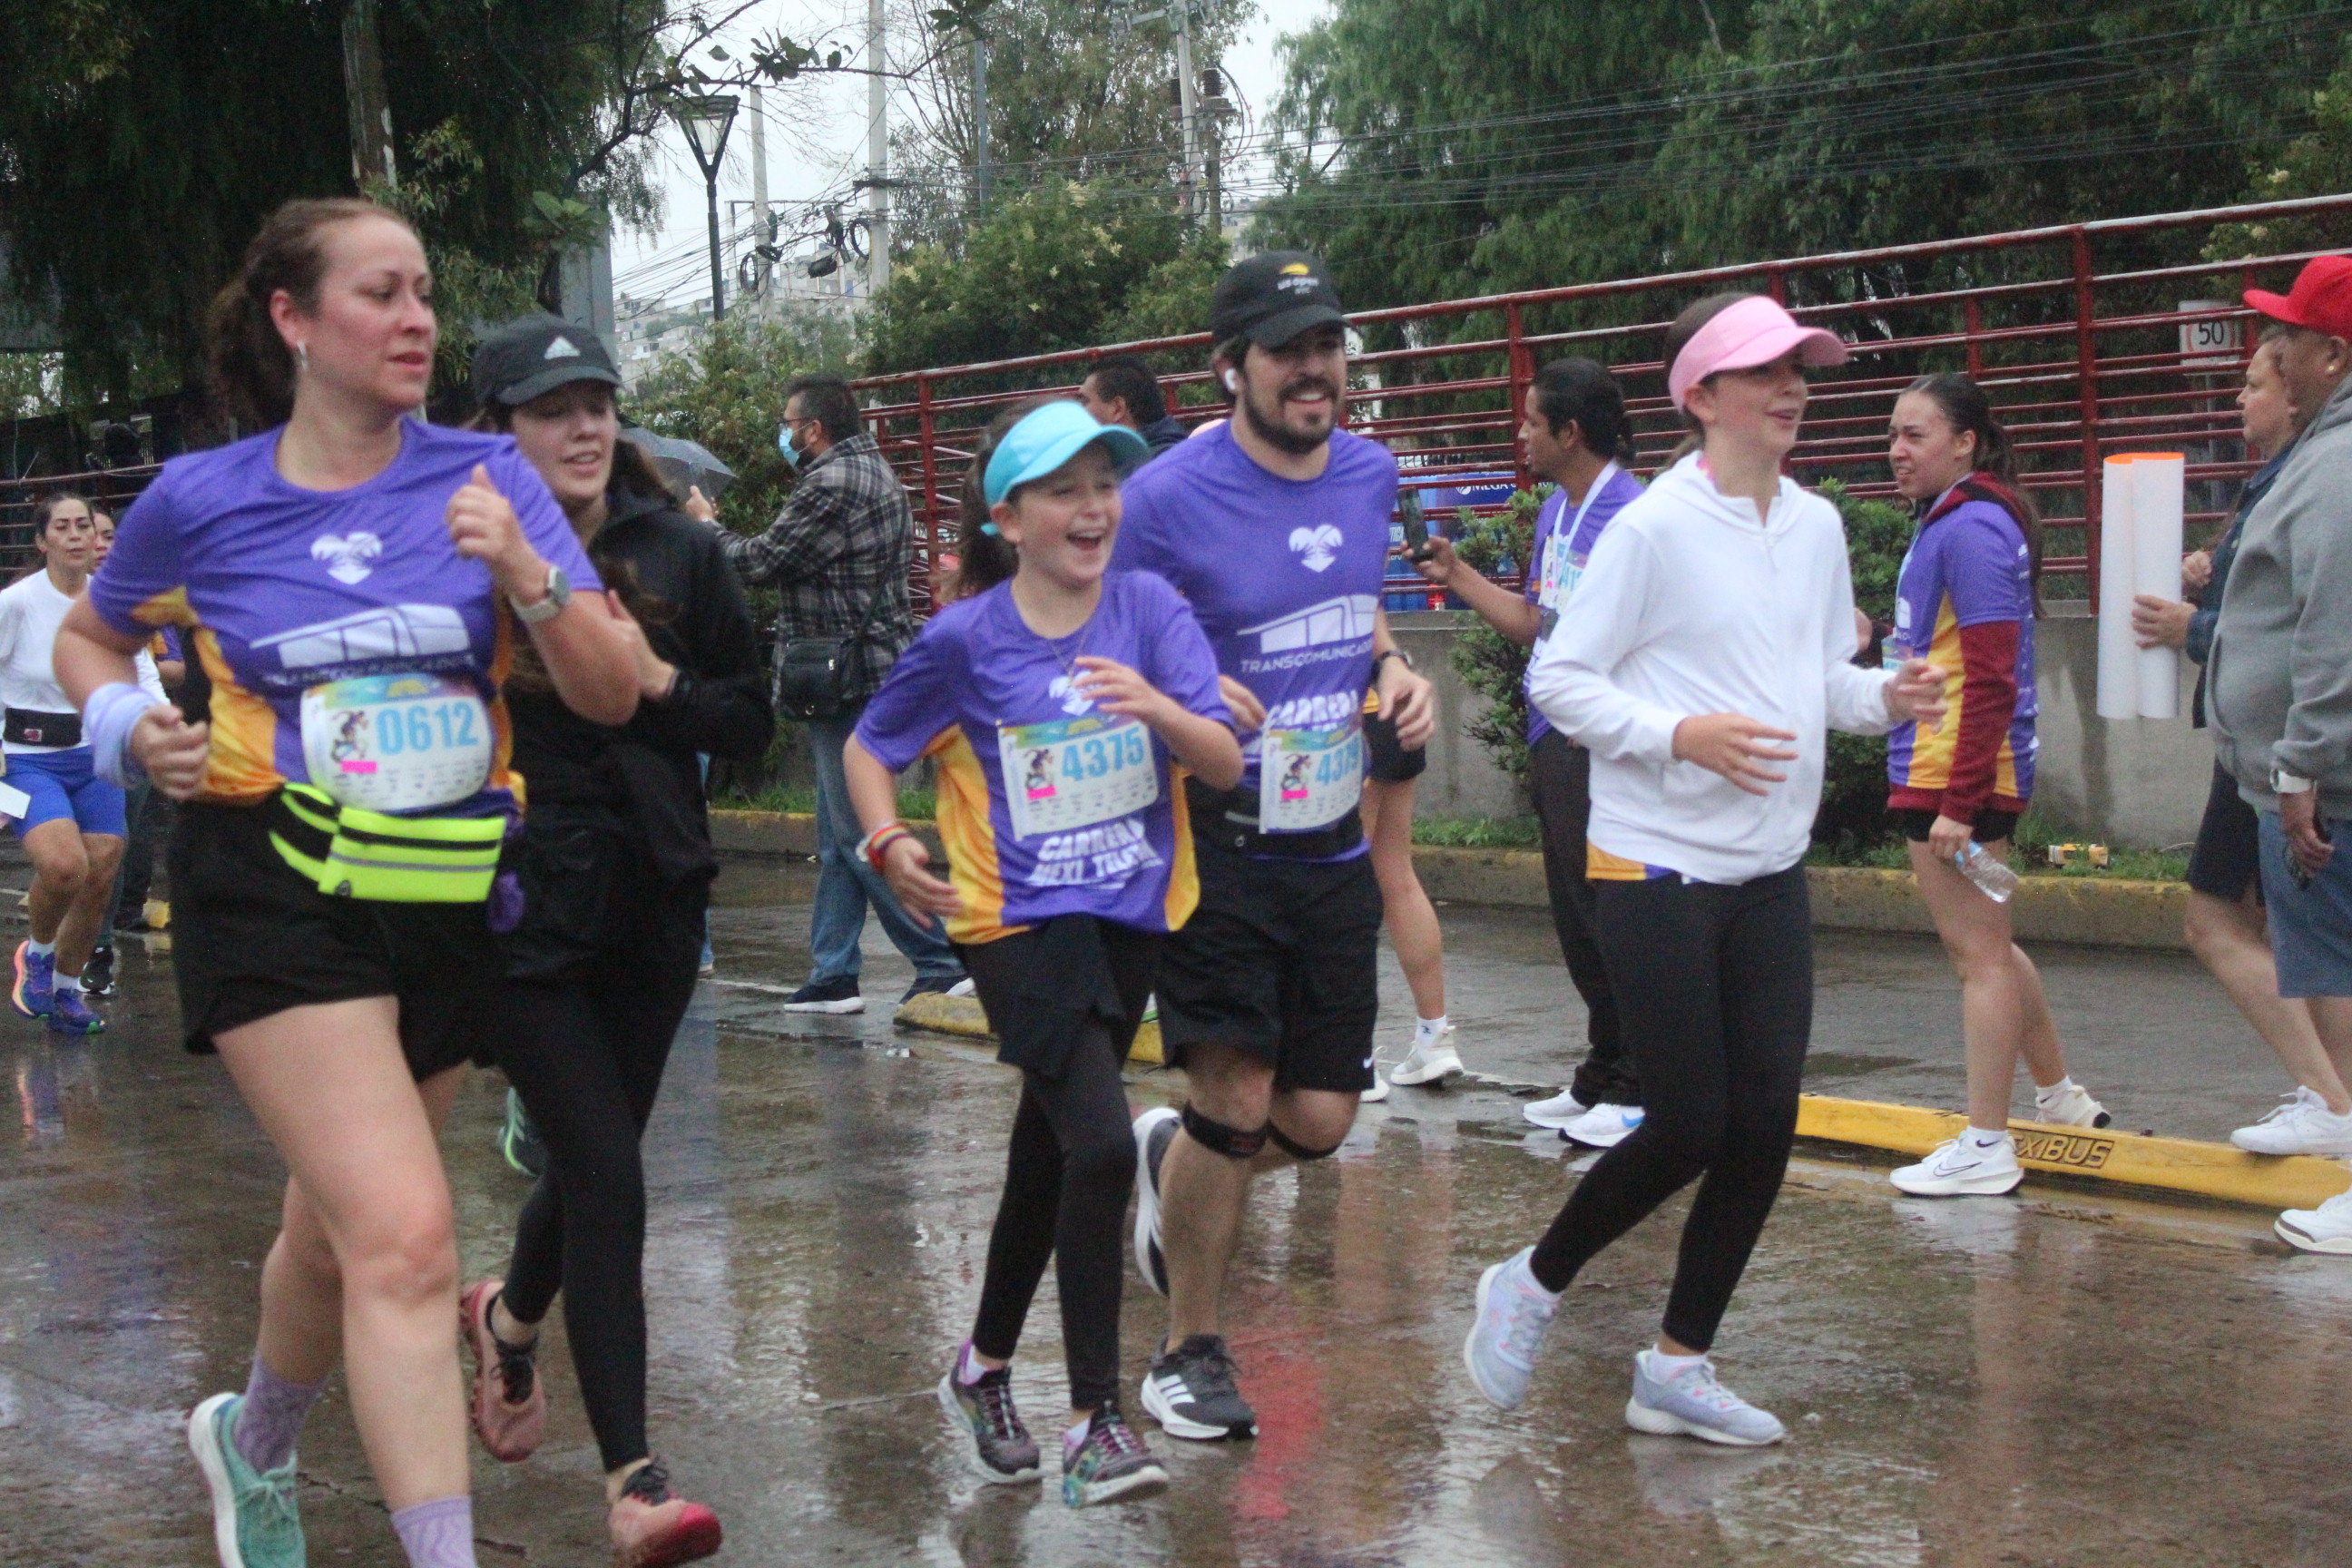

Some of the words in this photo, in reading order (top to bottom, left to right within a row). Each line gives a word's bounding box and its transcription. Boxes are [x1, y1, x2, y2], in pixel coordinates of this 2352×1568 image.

[2199, 321, 2224, 346] 50
[377, 701, 479, 756] 0612
[1061, 727, 1145, 782] 4375
